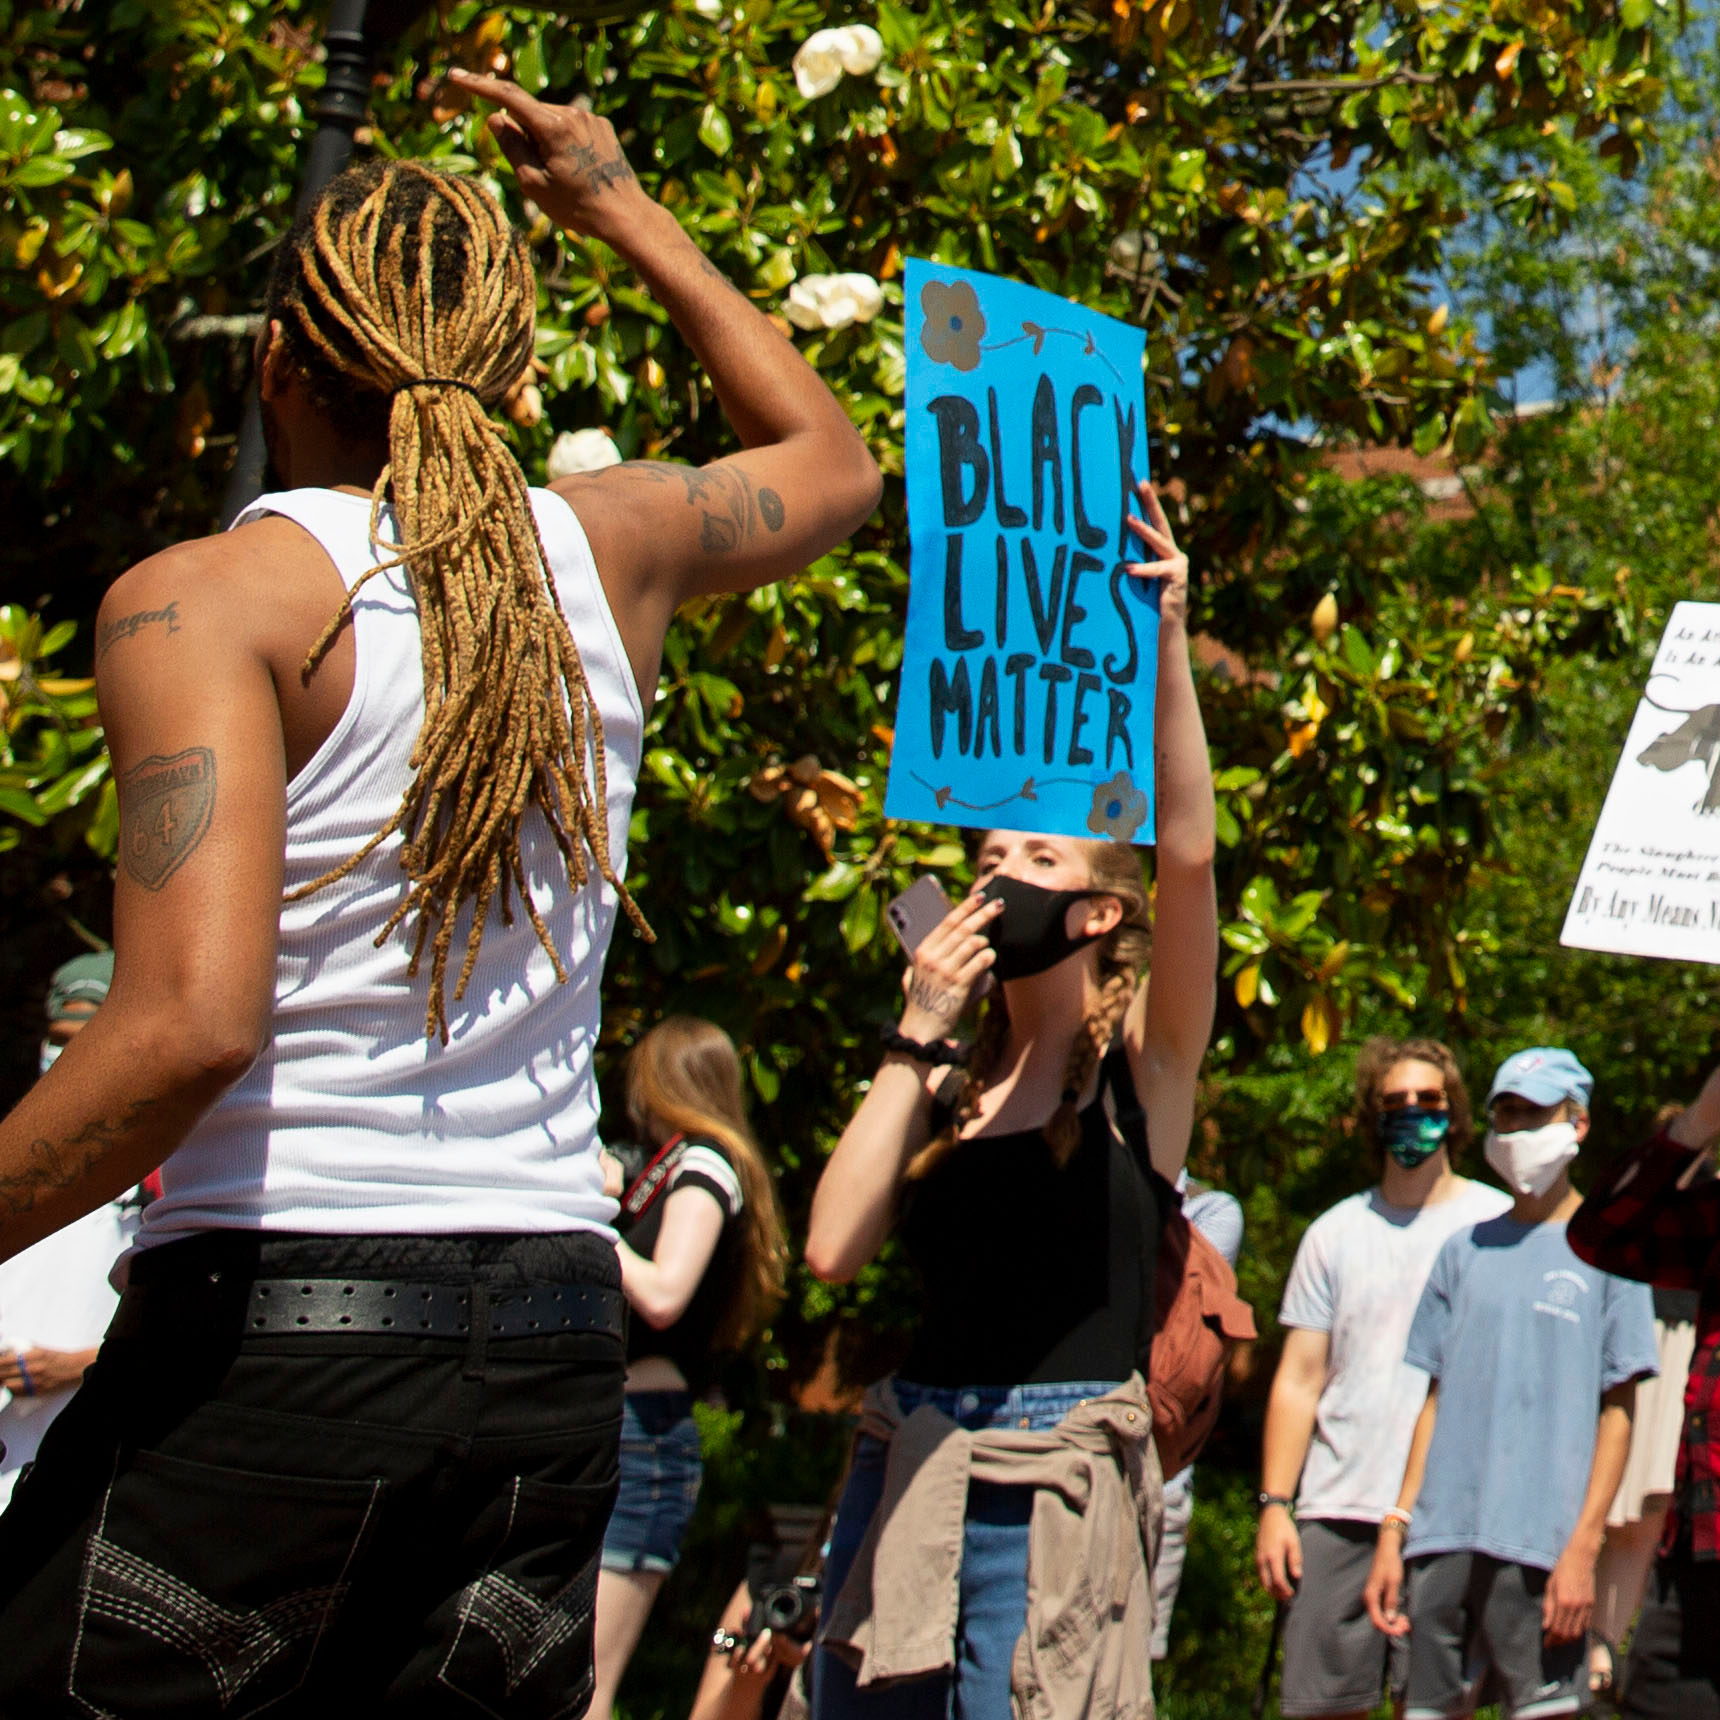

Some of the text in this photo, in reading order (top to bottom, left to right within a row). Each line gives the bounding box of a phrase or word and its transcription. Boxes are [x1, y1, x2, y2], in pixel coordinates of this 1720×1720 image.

[926, 372, 1154, 590] BLACK
[943, 533, 1140, 685] LIVES
[927, 653, 1135, 771] MATTER
